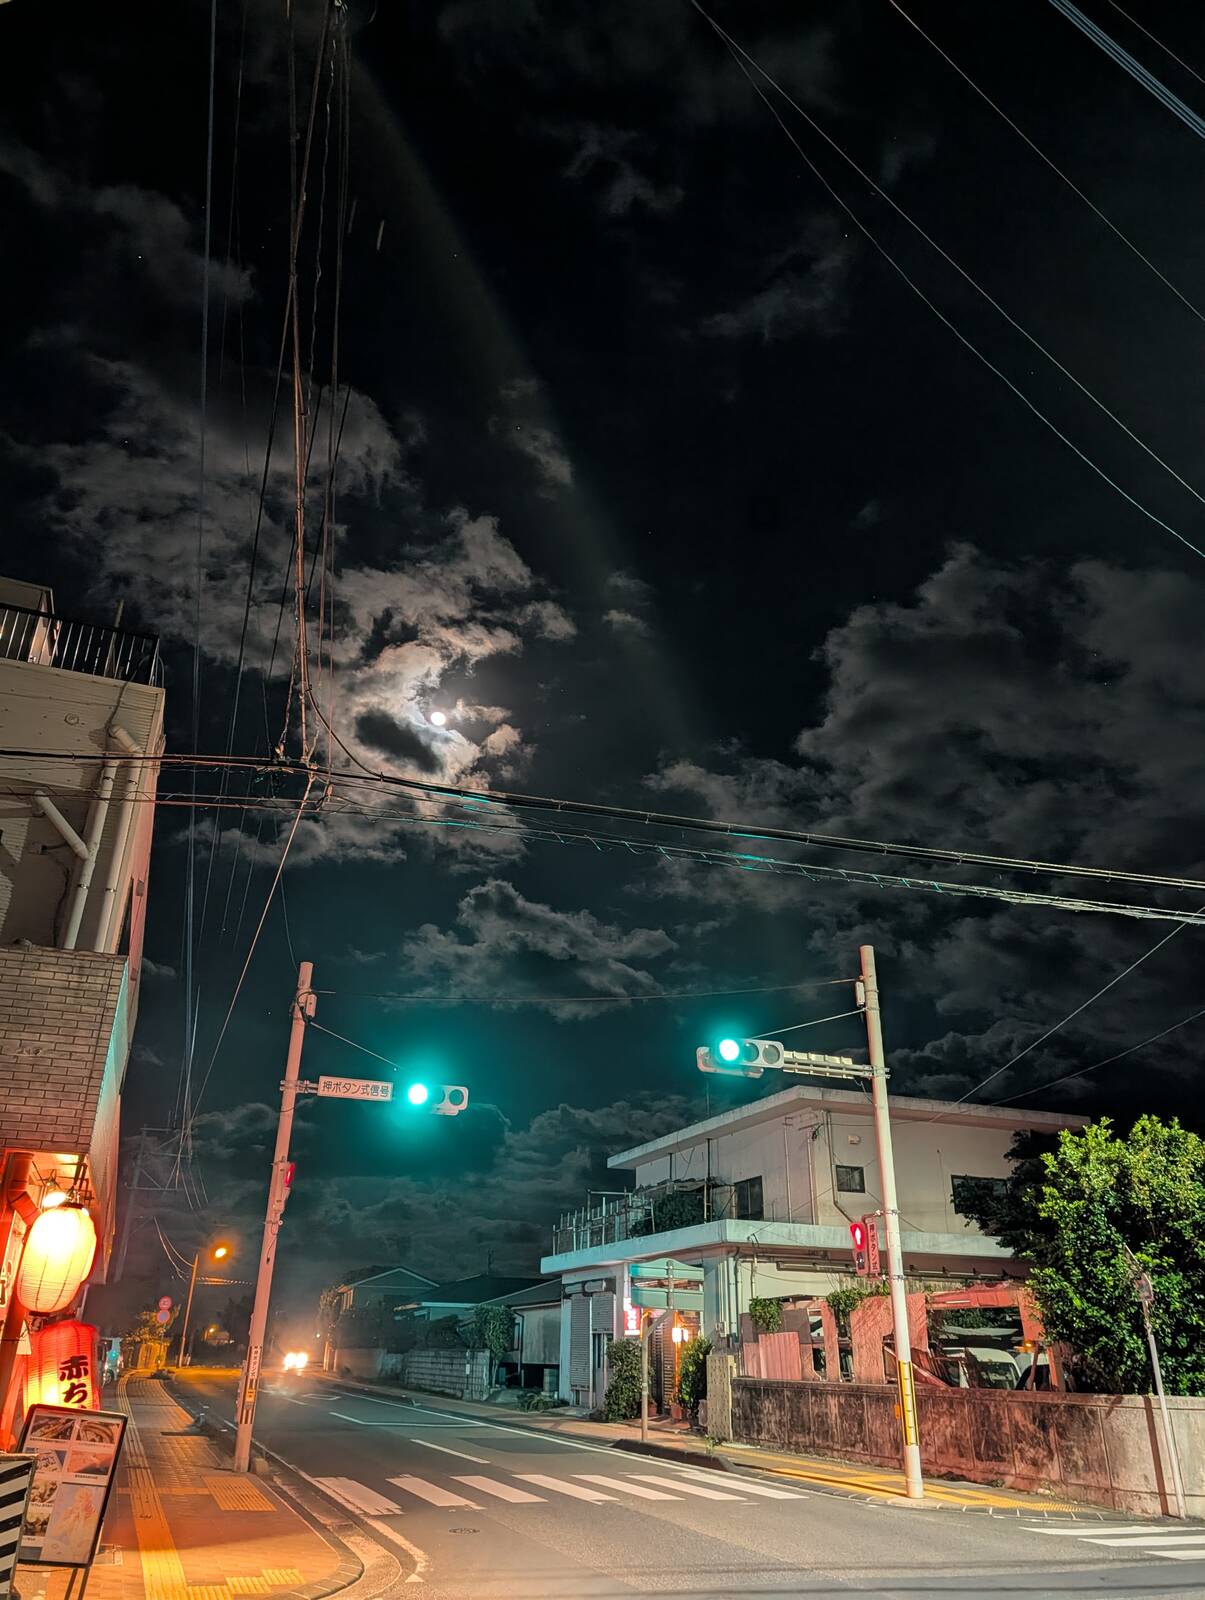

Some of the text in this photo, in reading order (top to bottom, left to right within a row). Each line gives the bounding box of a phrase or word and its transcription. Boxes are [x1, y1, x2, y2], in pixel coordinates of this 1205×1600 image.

[322, 1079, 390, 1098] 押ボタン式信号
[869, 1223, 878, 1271] 押ボタン式
[59, 1354, 89, 1409] 赤ち
